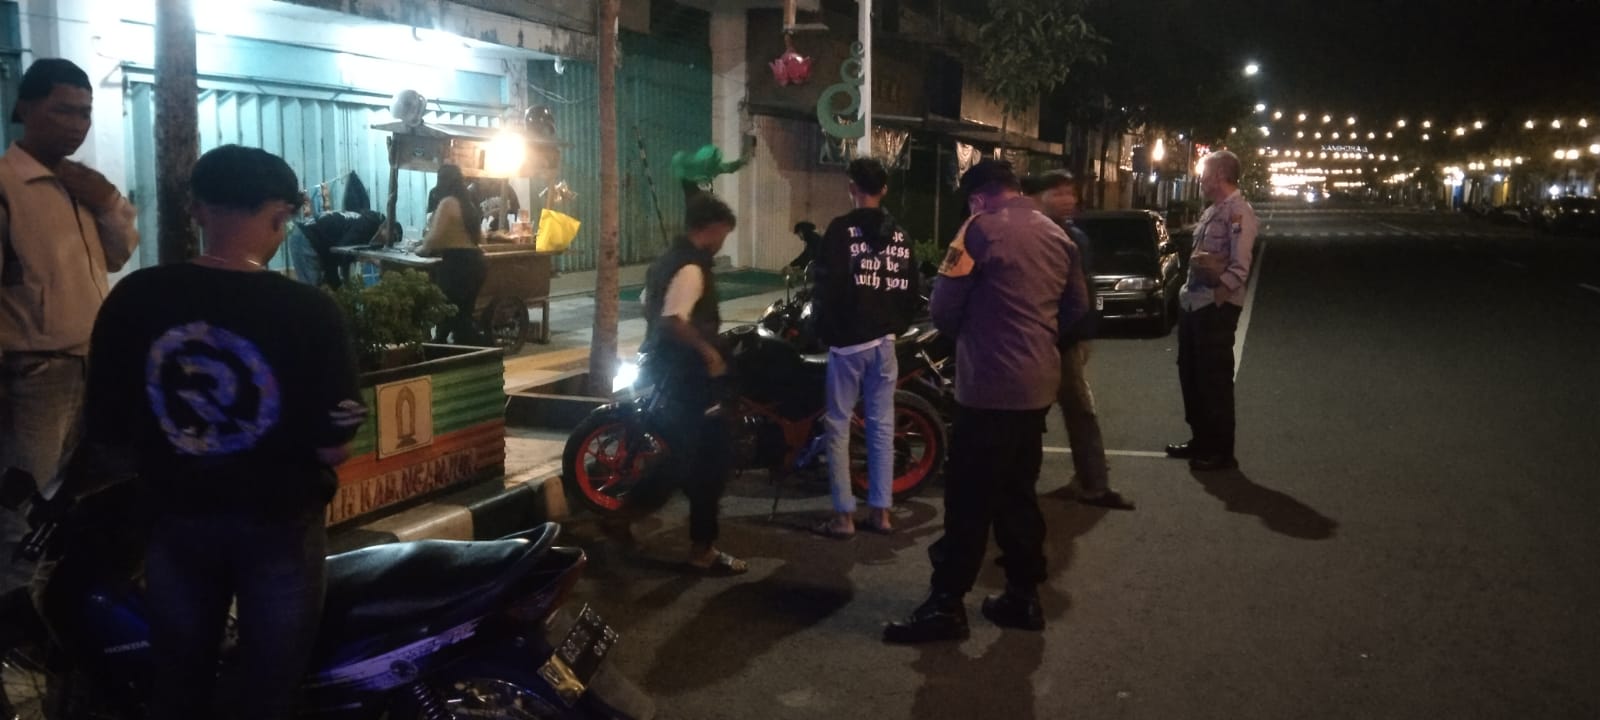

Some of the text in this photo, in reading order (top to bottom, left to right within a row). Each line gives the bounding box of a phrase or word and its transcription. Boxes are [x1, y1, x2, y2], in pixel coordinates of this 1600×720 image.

[861, 256, 899, 272] and be
[854, 272, 908, 291] with you
